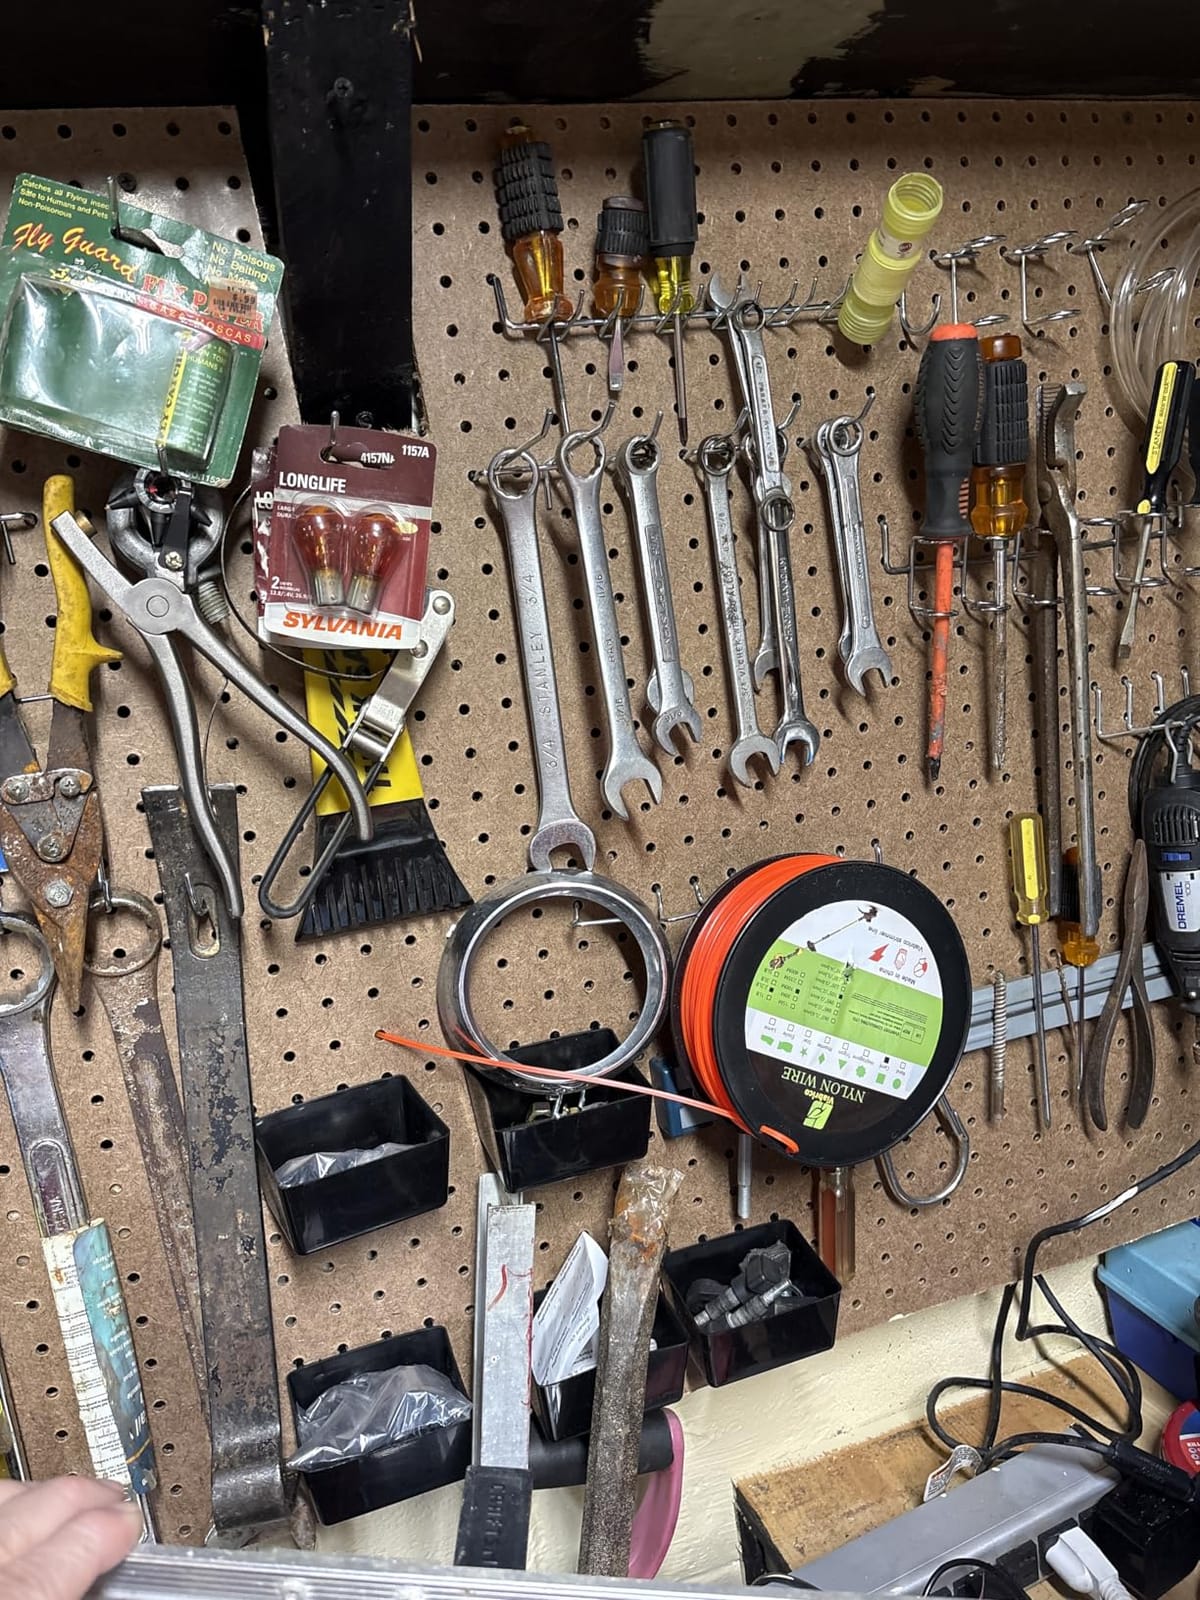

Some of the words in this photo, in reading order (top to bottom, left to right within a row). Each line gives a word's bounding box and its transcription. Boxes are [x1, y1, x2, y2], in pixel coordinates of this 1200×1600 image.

[18, 198, 72, 219] Non-Poisonous
[20, 188, 36, 198] Safe
[47, 196, 75, 210] Humans
[77, 204, 91, 214] and
[92, 209, 108, 219] Pets
[22, 179, 51, 193] Catches
[66, 191, 88, 204] Flying
[90, 198, 109, 210] insec
[11, 222, 54, 253] Fly
[62, 227, 137, 283] Guard
[210, 252, 225, 266] No
[230, 260, 268, 282] Baiting
[212, 241, 228, 255] No
[234, 249, 276, 272] Poisons
[207, 263, 221, 276] No
[402, 444, 430, 458] 1157A
[279, 472, 347, 494] LONGLIFE
[271, 576, 280, 590] 2
[526, 574, 538, 604] 3/4
[283, 612, 403, 640] SYLVANIA
[530, 631, 551, 715] STANLEY
[1174, 882, 1186, 929] DREMEL
[781, 1065, 818, 1088] WIRE
[818, 1079, 866, 1103] NYLON
